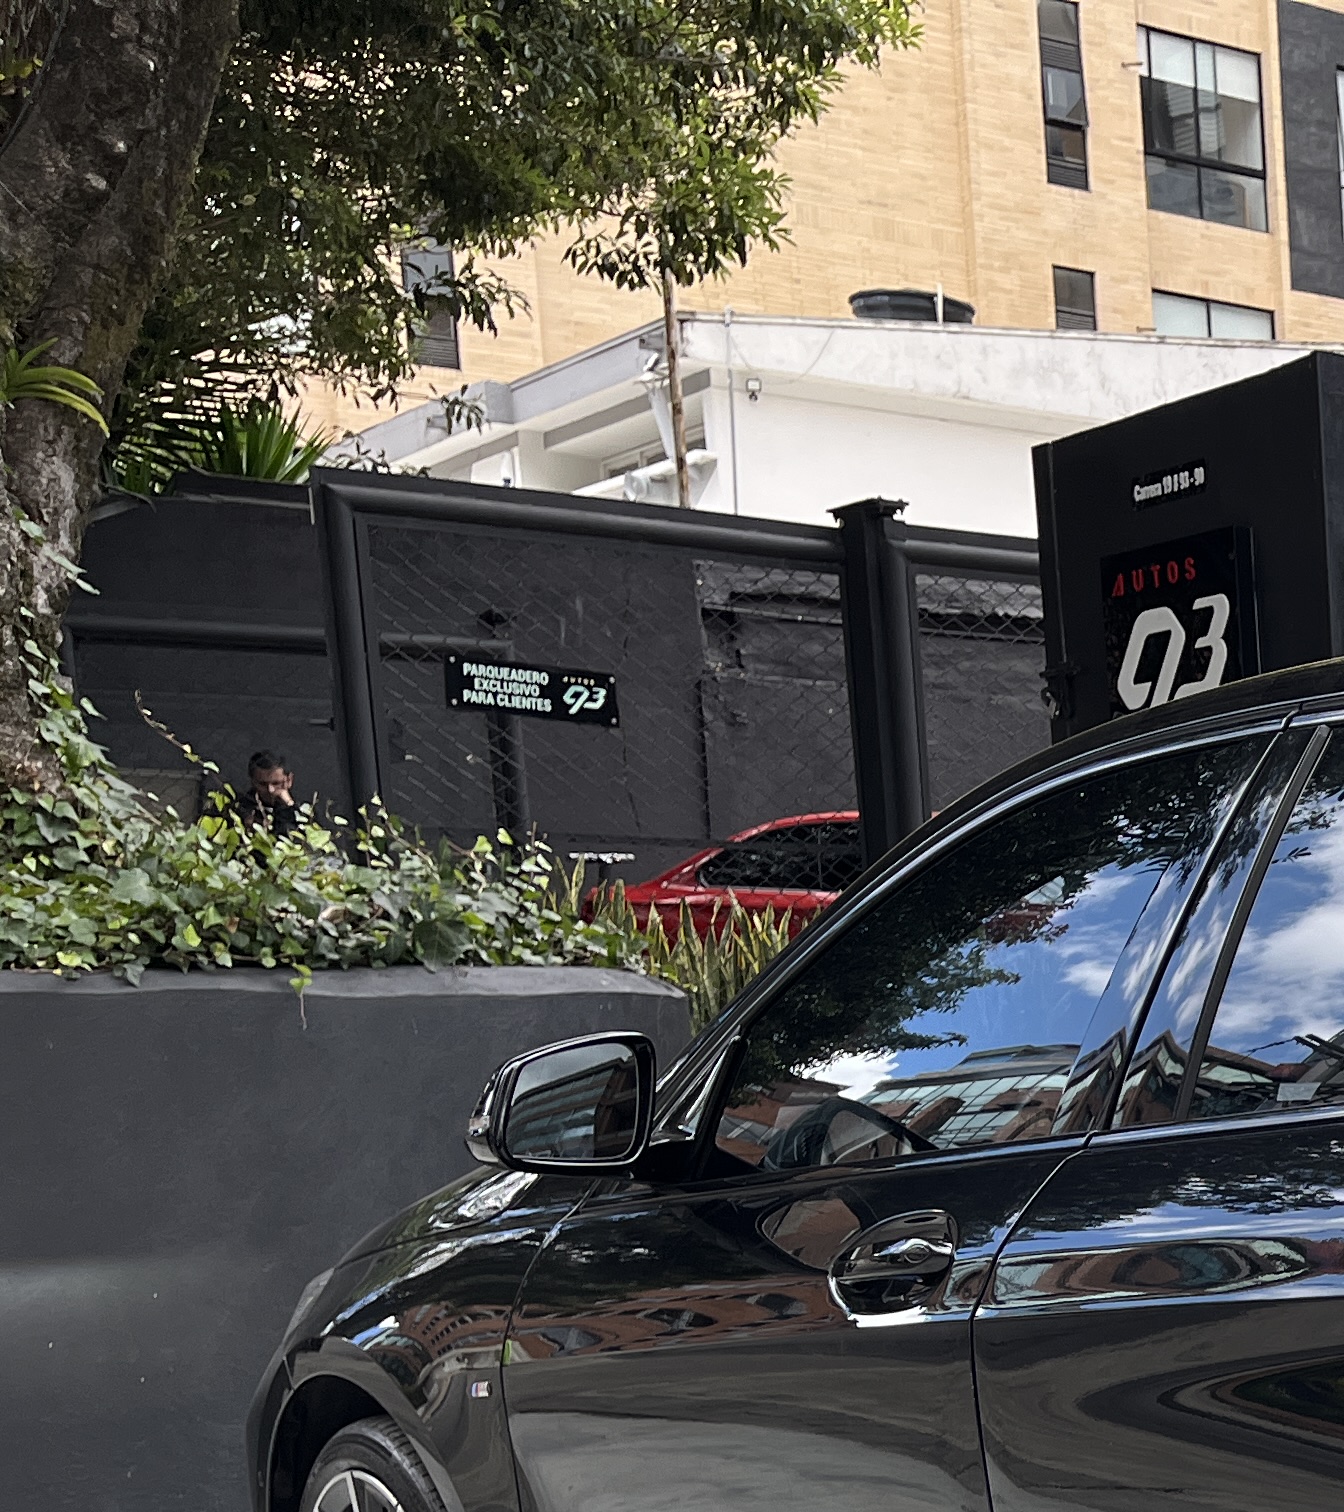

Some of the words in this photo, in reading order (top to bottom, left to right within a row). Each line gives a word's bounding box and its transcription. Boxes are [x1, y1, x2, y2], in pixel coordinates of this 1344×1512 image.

[1112, 557, 1197, 598] AUTOS
[1117, 593, 1230, 711] 93
[463, 662, 549, 686] PARQUEADERO
[463, 689, 495, 706] PARA
[496, 695, 552, 713] CLIENTES
[474, 678, 540, 698] EXCLUSIVO
[563, 685, 607, 714] 93
